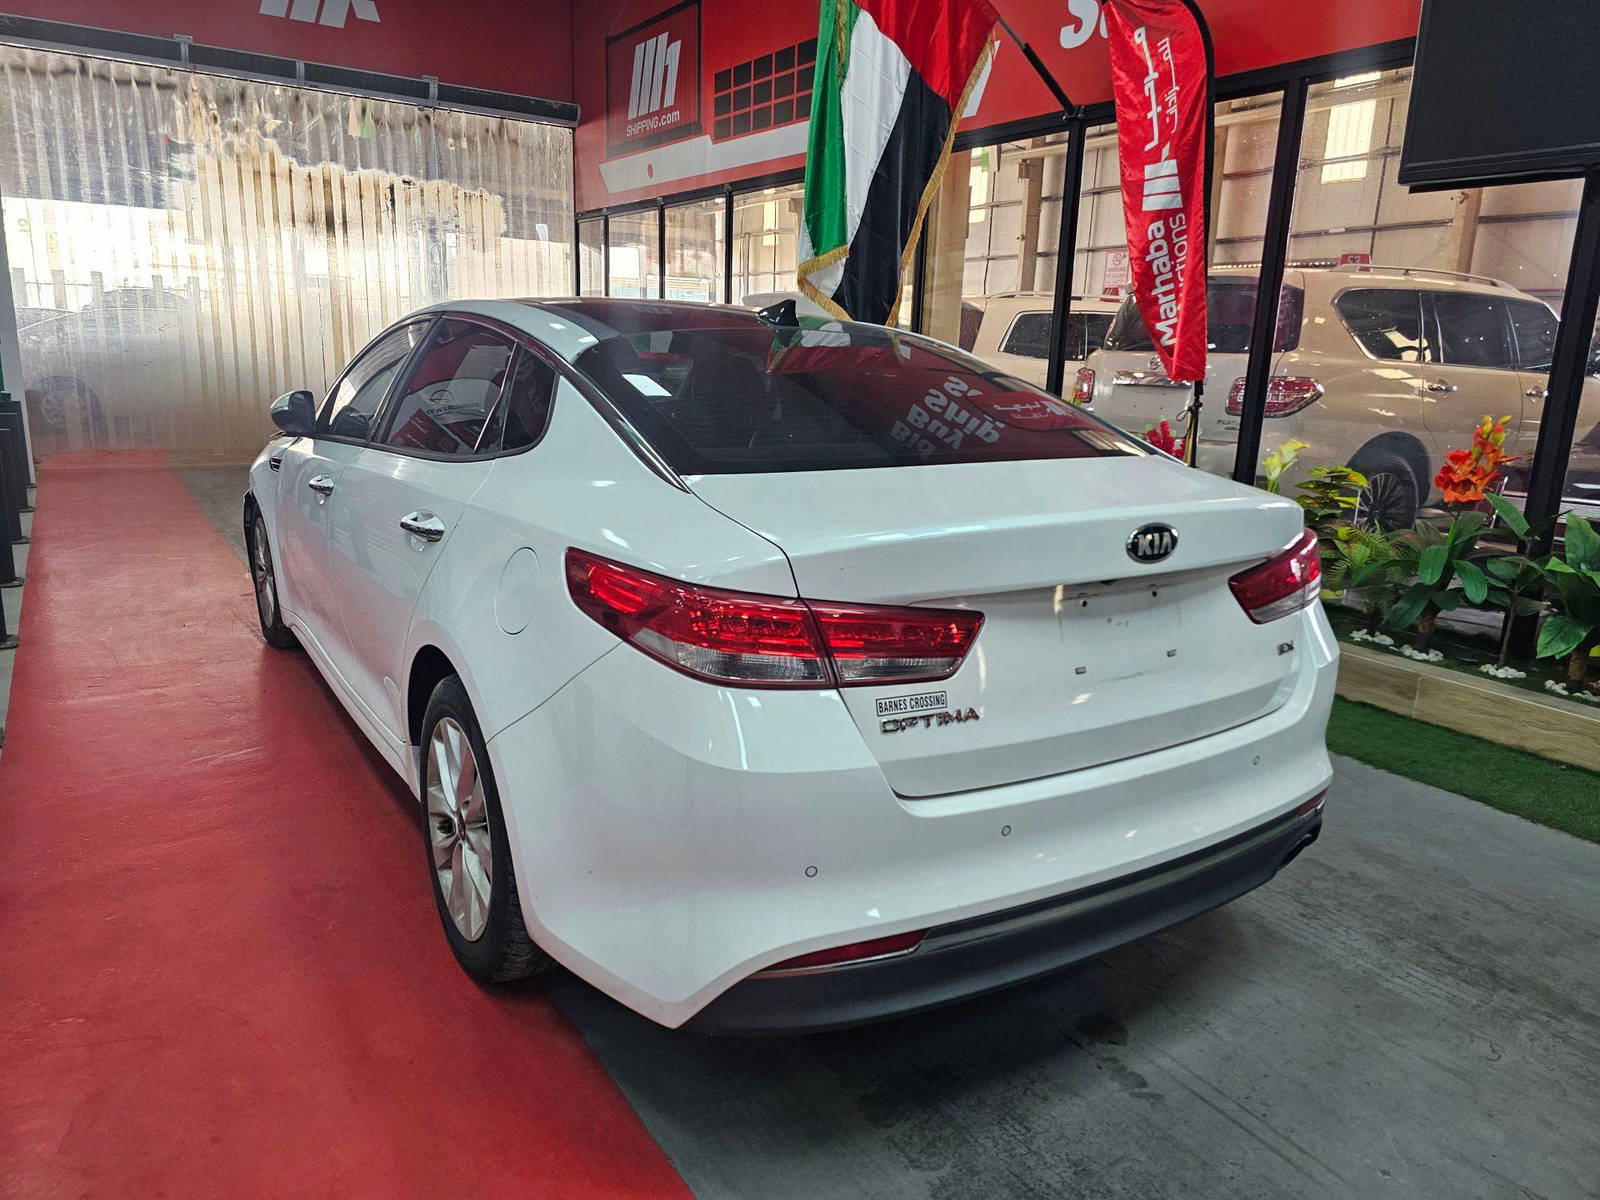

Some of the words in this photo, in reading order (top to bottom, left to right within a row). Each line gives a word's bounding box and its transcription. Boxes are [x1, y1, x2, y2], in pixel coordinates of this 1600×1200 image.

[627, 110, 680, 137] SHIPPING.com
[1145, 219, 1178, 347] Marhaba
[1137, 531, 1173, 556] KIA
[878, 698, 907, 713] BARNES
[910, 694, 946, 710] CROSSING
[880, 707, 981, 733] OPTIMA
